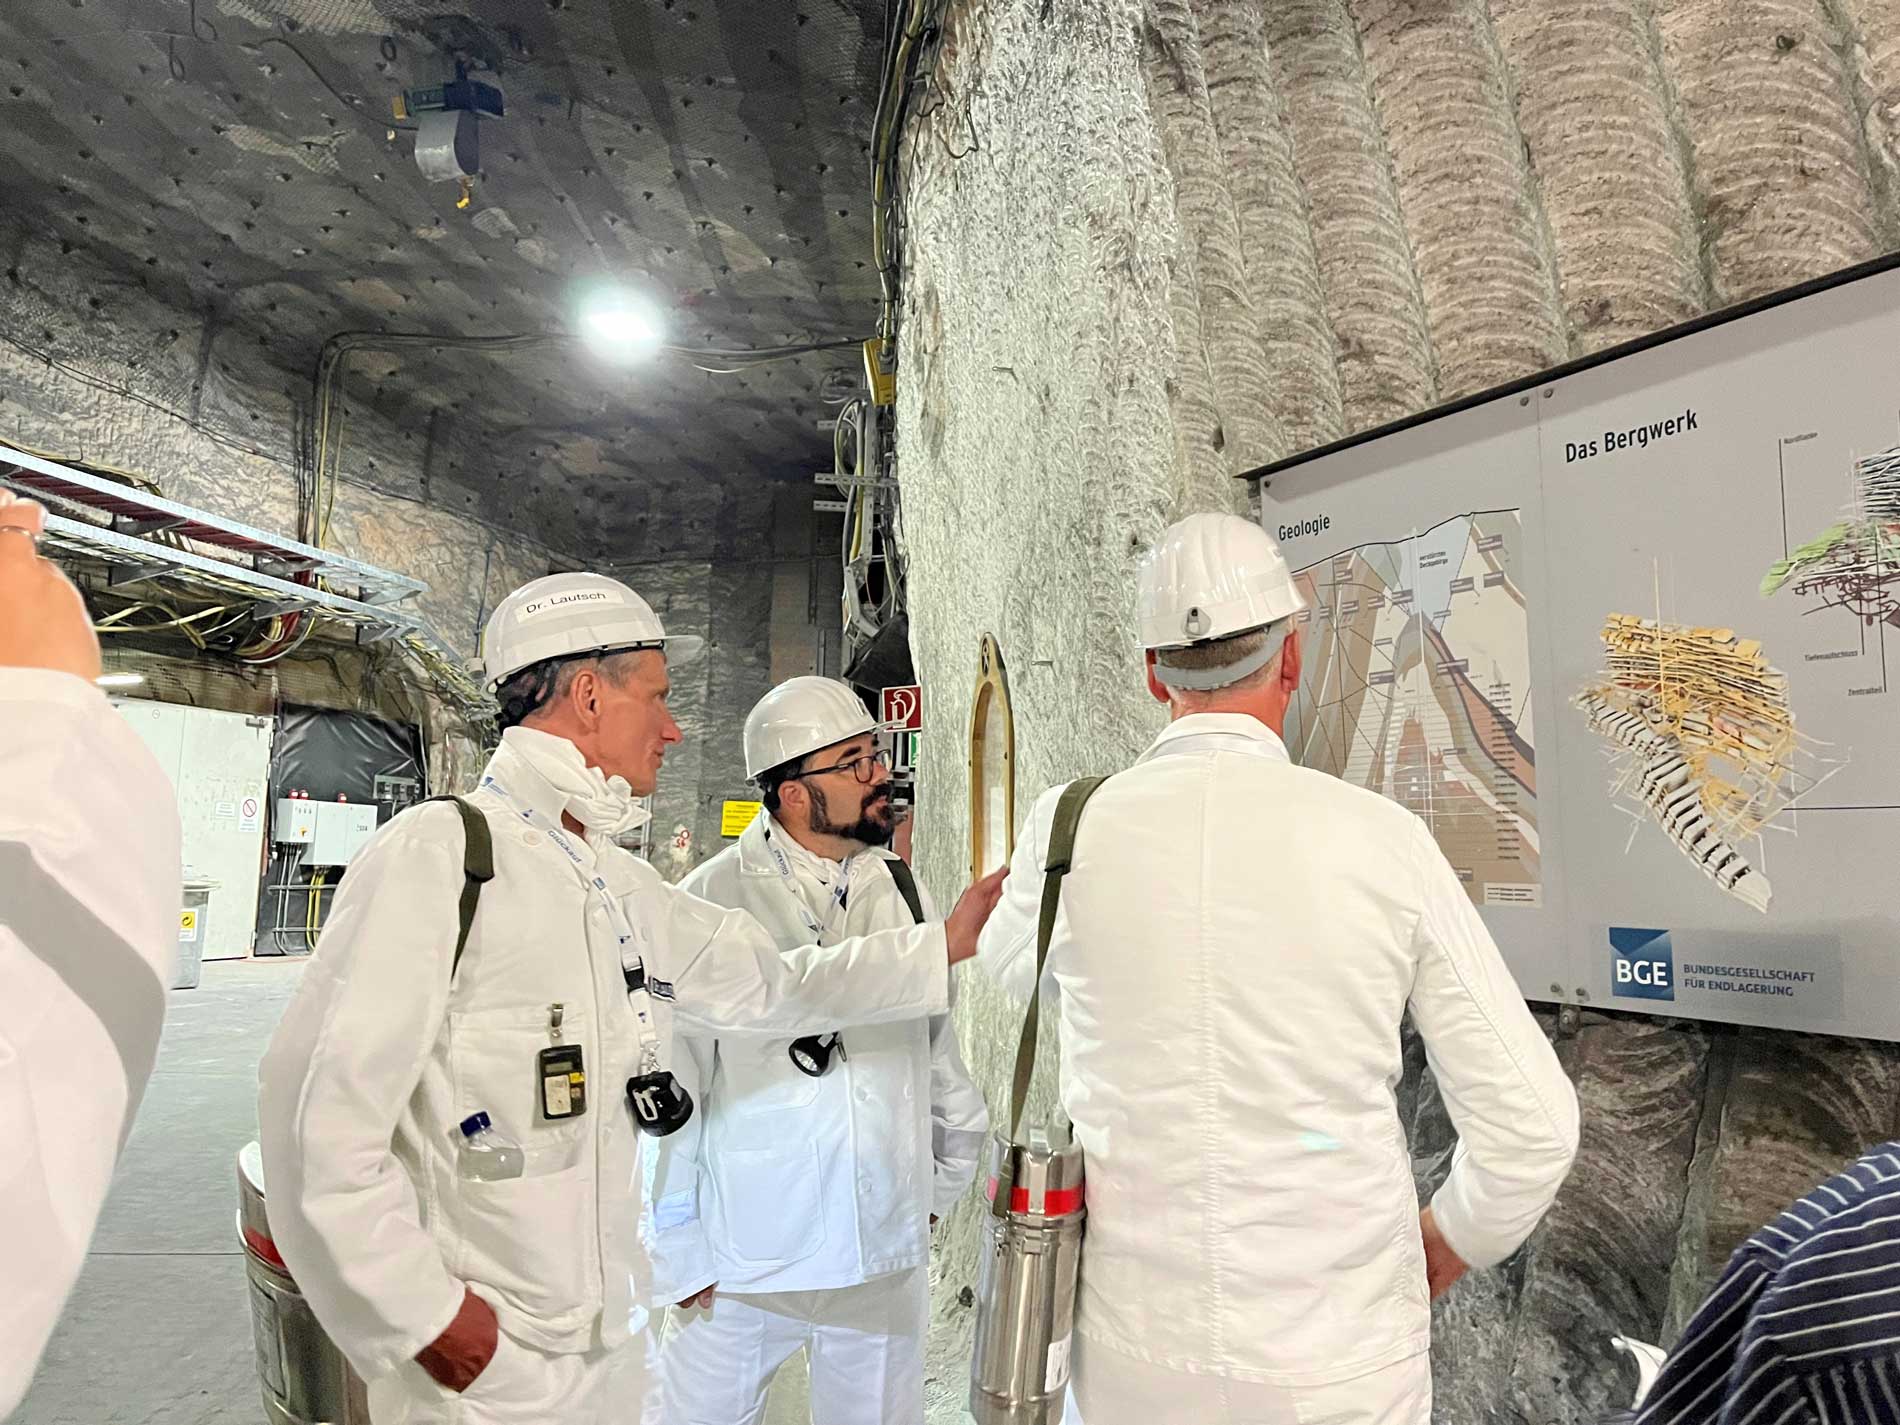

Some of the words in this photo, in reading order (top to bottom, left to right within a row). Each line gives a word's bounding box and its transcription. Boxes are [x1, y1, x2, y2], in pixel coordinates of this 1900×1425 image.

[1566, 441, 1598, 463] Das
[1604, 409, 1698, 453] Bergwerk
[1279, 514, 1330, 541] Geologie
[526, 603, 547, 613] Dr.
[550, 592, 607, 605] Lautsch
[1615, 958, 1669, 987] BGE
[1683, 963, 1815, 983] BUNDESGESELLSCHAFT
[1684, 977, 1706, 989] FÜR
[1708, 980, 1794, 997] ENDLAGERUNG
